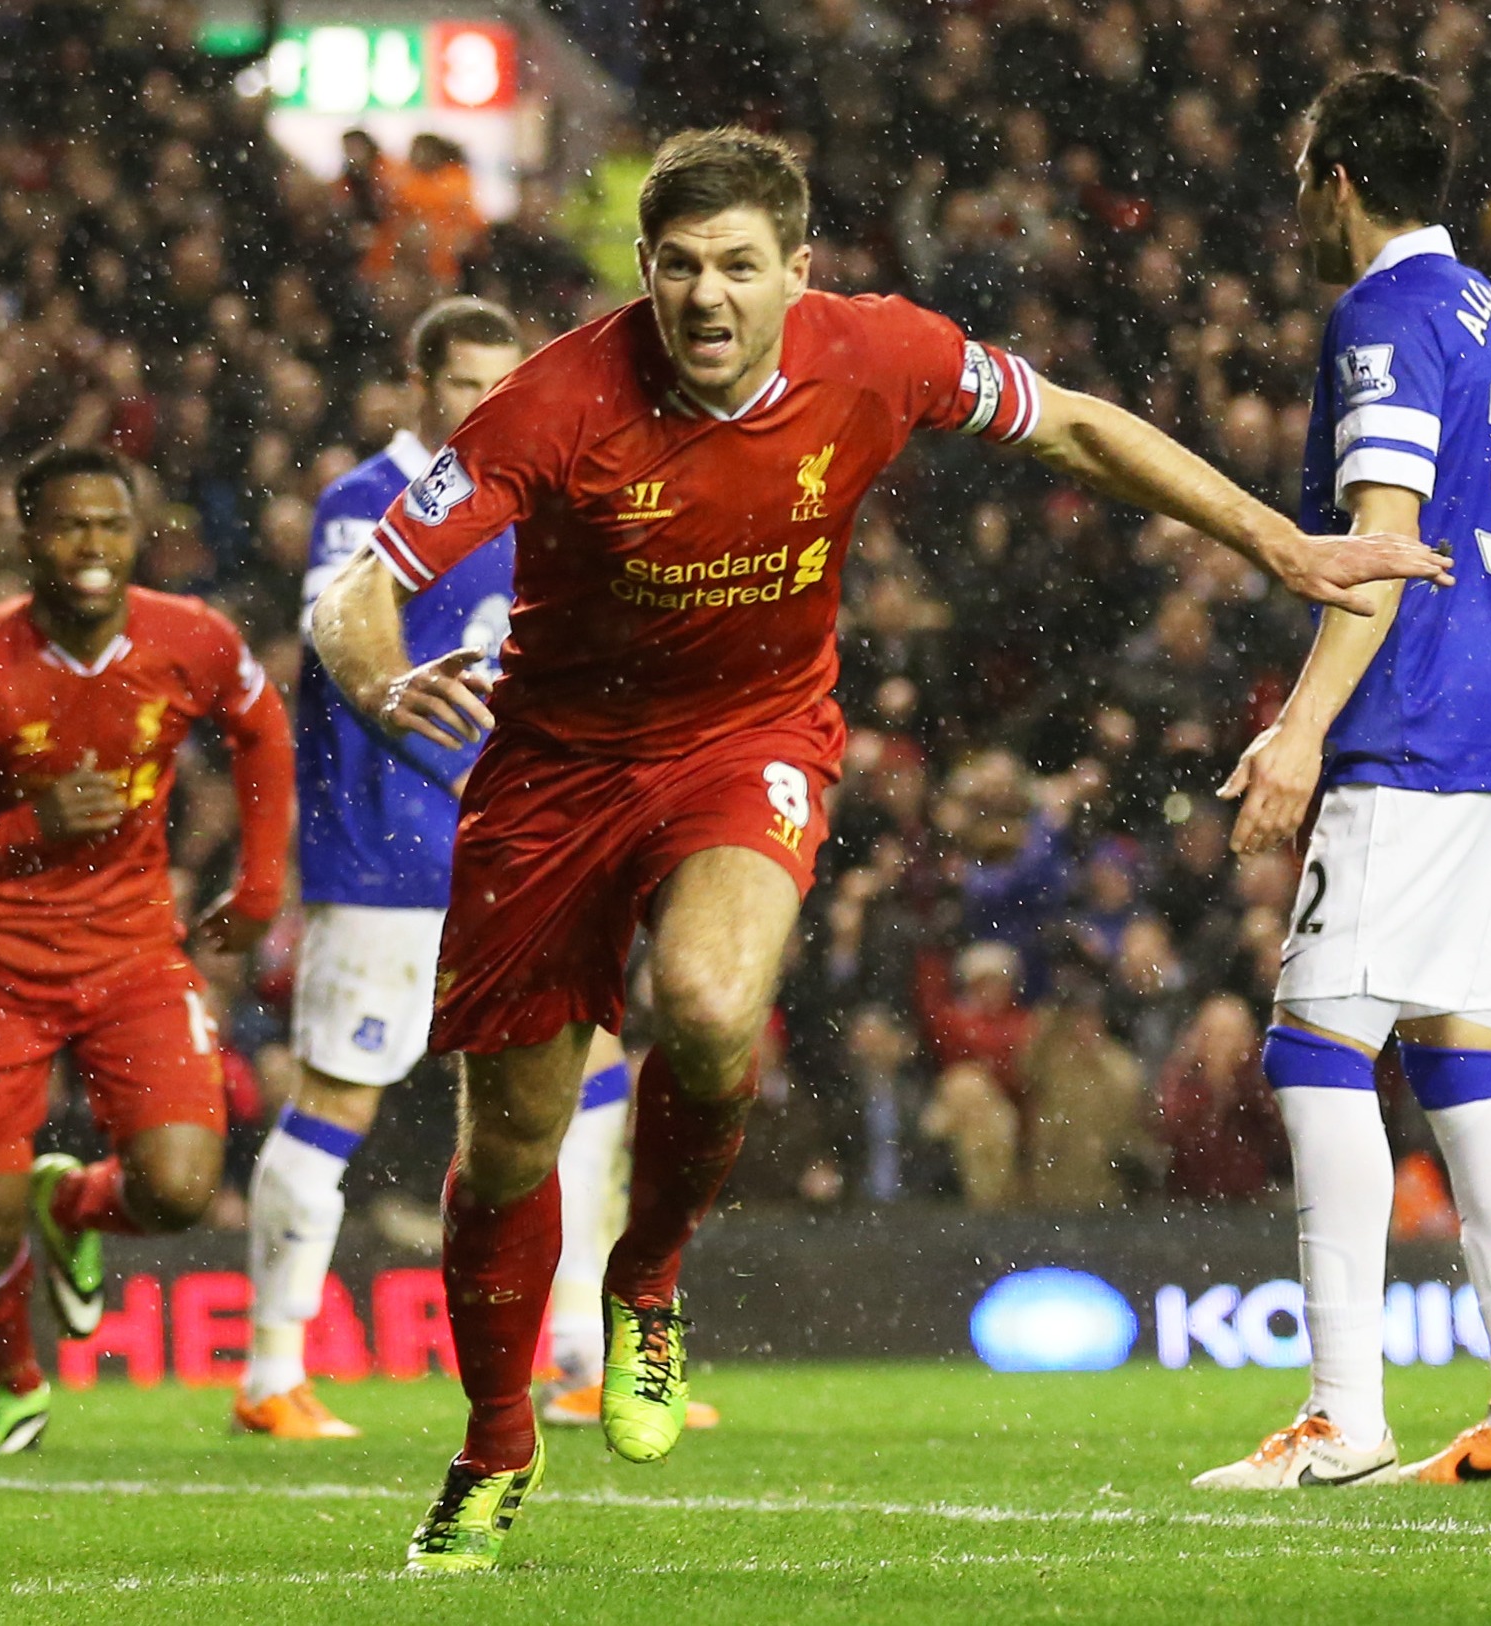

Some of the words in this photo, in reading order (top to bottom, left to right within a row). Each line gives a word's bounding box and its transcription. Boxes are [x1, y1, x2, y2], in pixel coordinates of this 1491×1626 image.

[610, 577, 784, 610] Chartered
[625, 545, 788, 585] Standard
[763, 761, 810, 829] 8
[184, 990, 220, 1055] 1
[57, 1268, 558, 1390] HEAR
